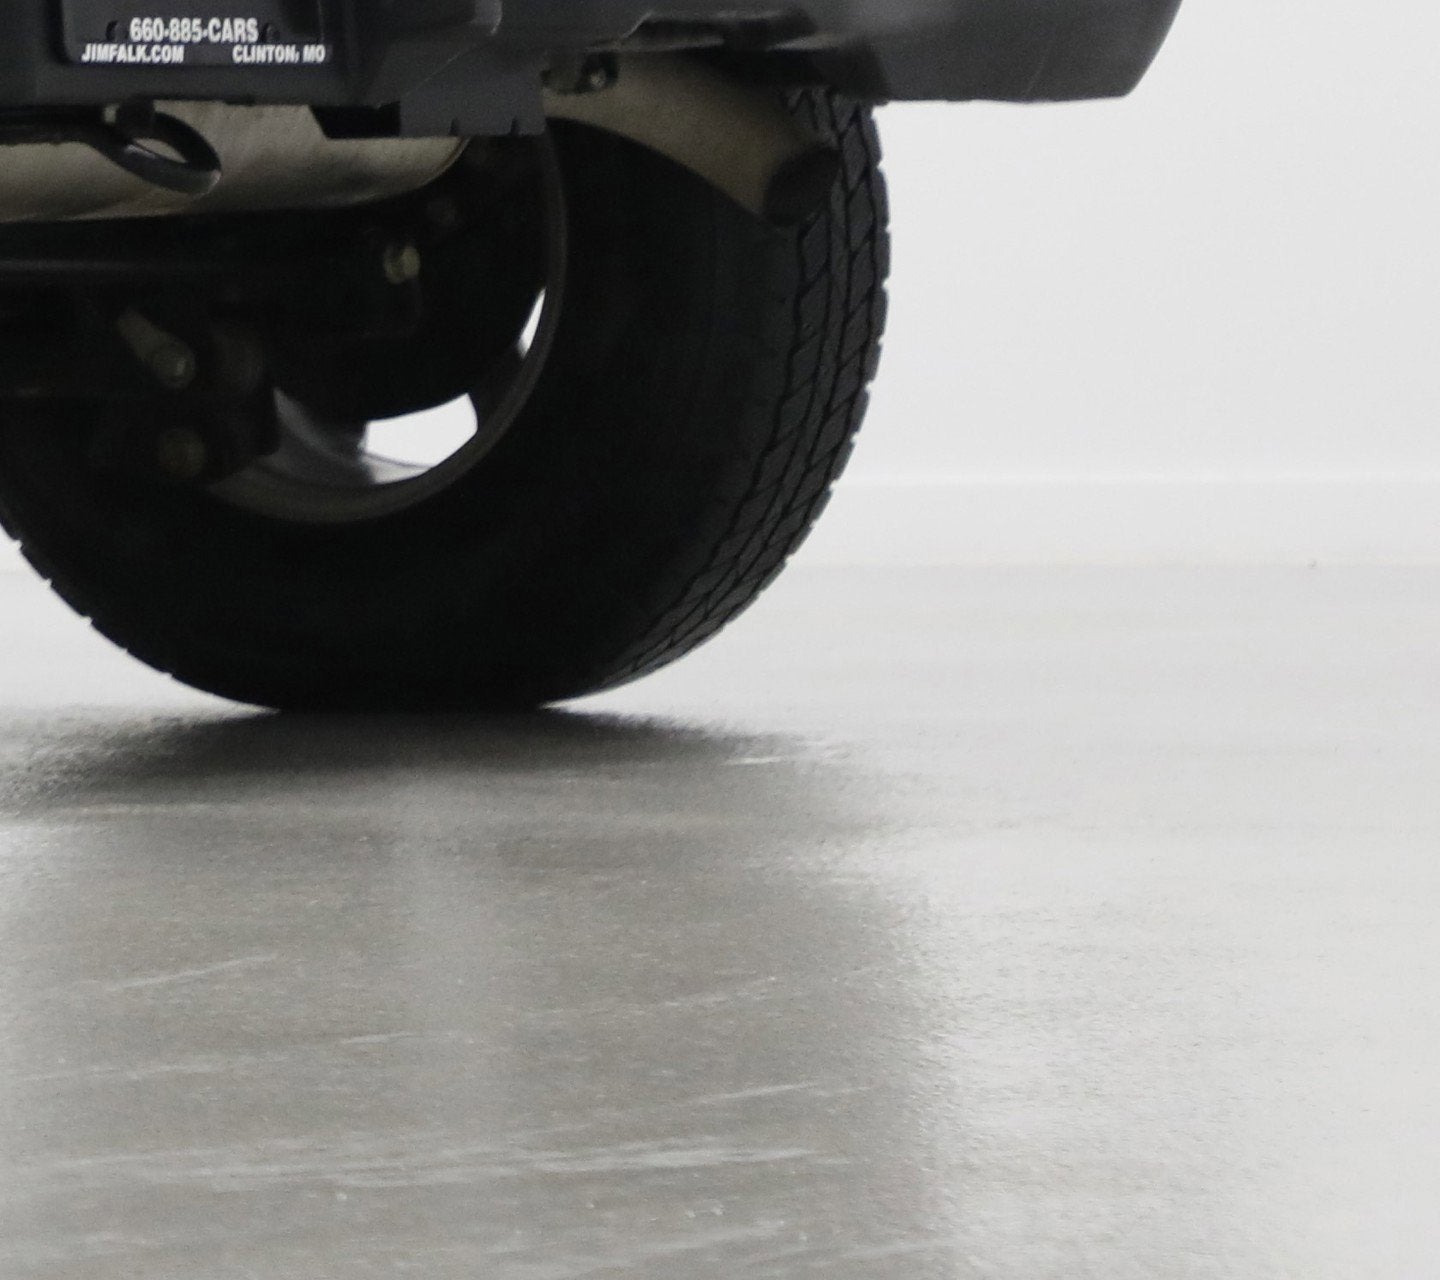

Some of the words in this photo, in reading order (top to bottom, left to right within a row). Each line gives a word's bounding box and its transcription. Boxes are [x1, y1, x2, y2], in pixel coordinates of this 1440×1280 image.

[81, 43, 184, 63] JIMFALK.COM
[232, 44, 300, 64] CLINTON,
[302, 44, 326, 63] MO
